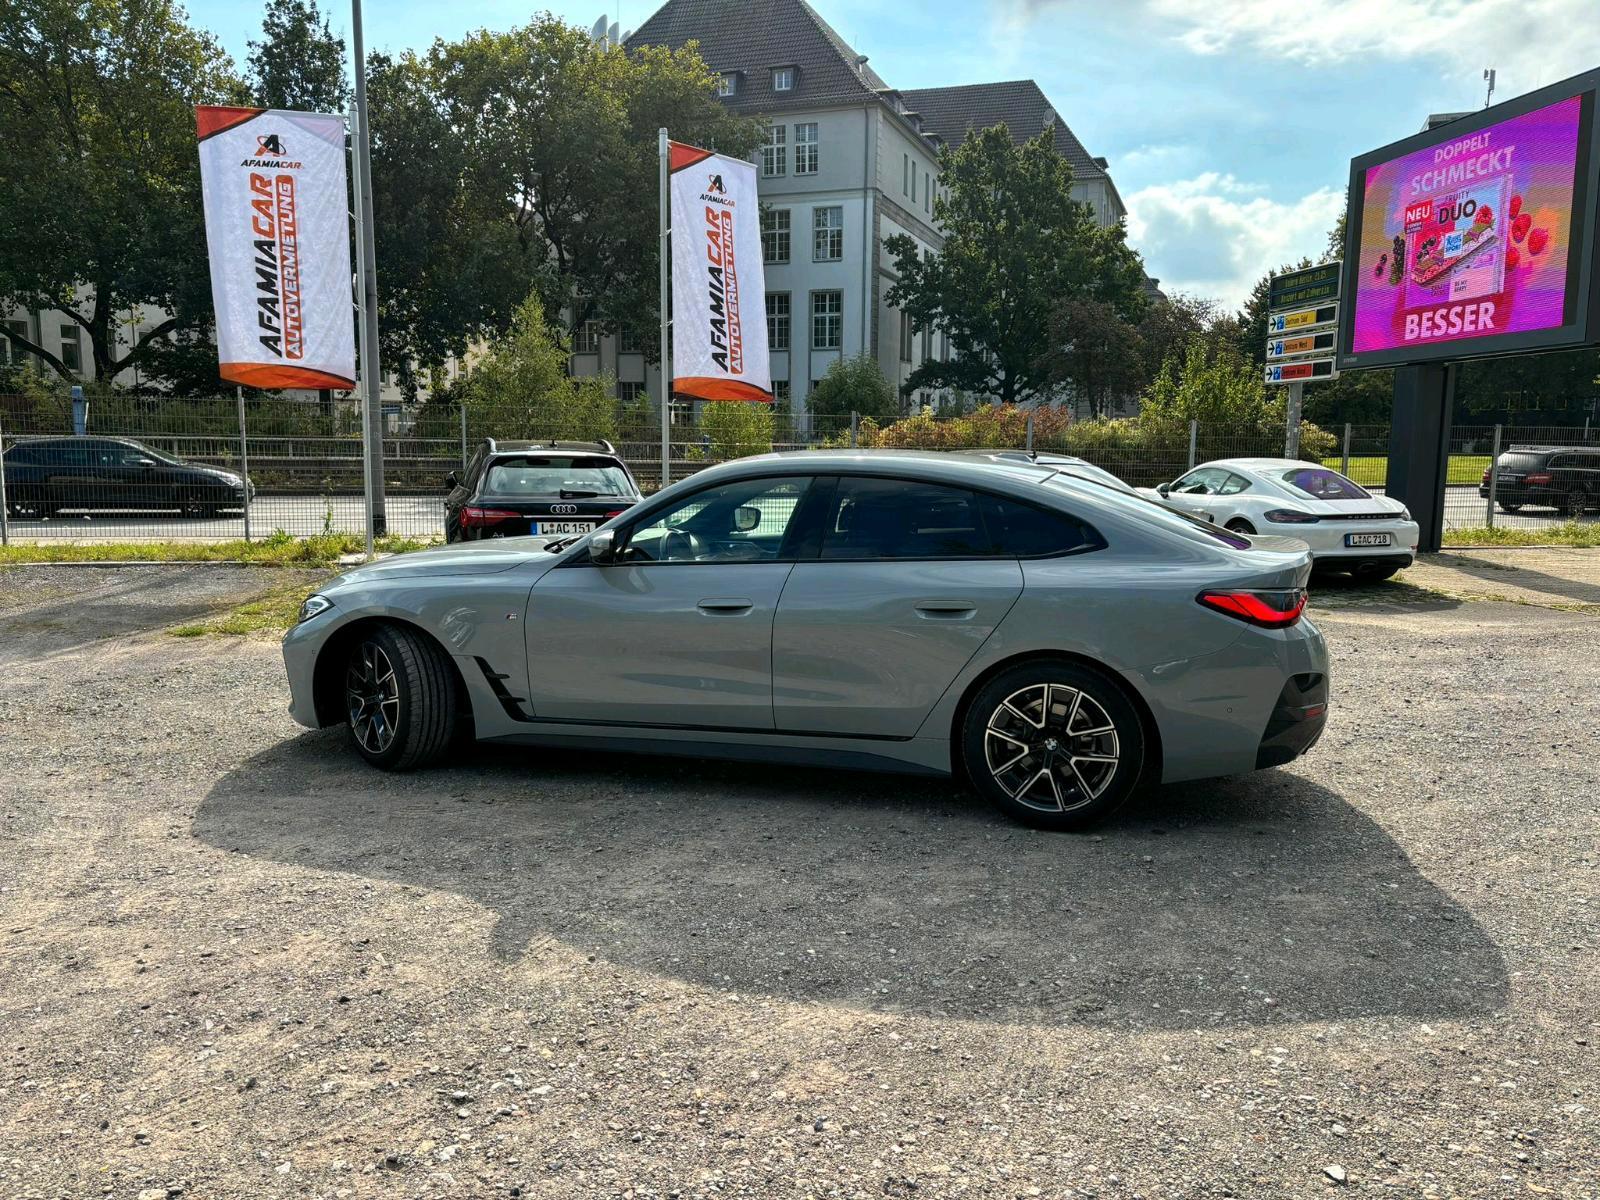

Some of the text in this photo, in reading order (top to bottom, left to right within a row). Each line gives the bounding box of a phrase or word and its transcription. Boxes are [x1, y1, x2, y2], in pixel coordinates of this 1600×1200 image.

[1434, 131, 1492, 163] DOPPELT
[241, 159, 302, 169] AFAMIACAR
[1411, 145, 1516, 196] SCHMECKT
[1406, 205, 1431, 222] NEU
[1438, 199, 1477, 224] DUO
[278, 183, 301, 357] AUTOVERMIETUNG
[722, 218, 742, 372] AUTOVERMIETUNG
[1404, 302, 1495, 340] BESSER
[556, 522, 571, 533] AC
[572, 522, 592, 532] 151
[1362, 536, 1372, 544] AC
[1374, 536, 1387, 544] 718
